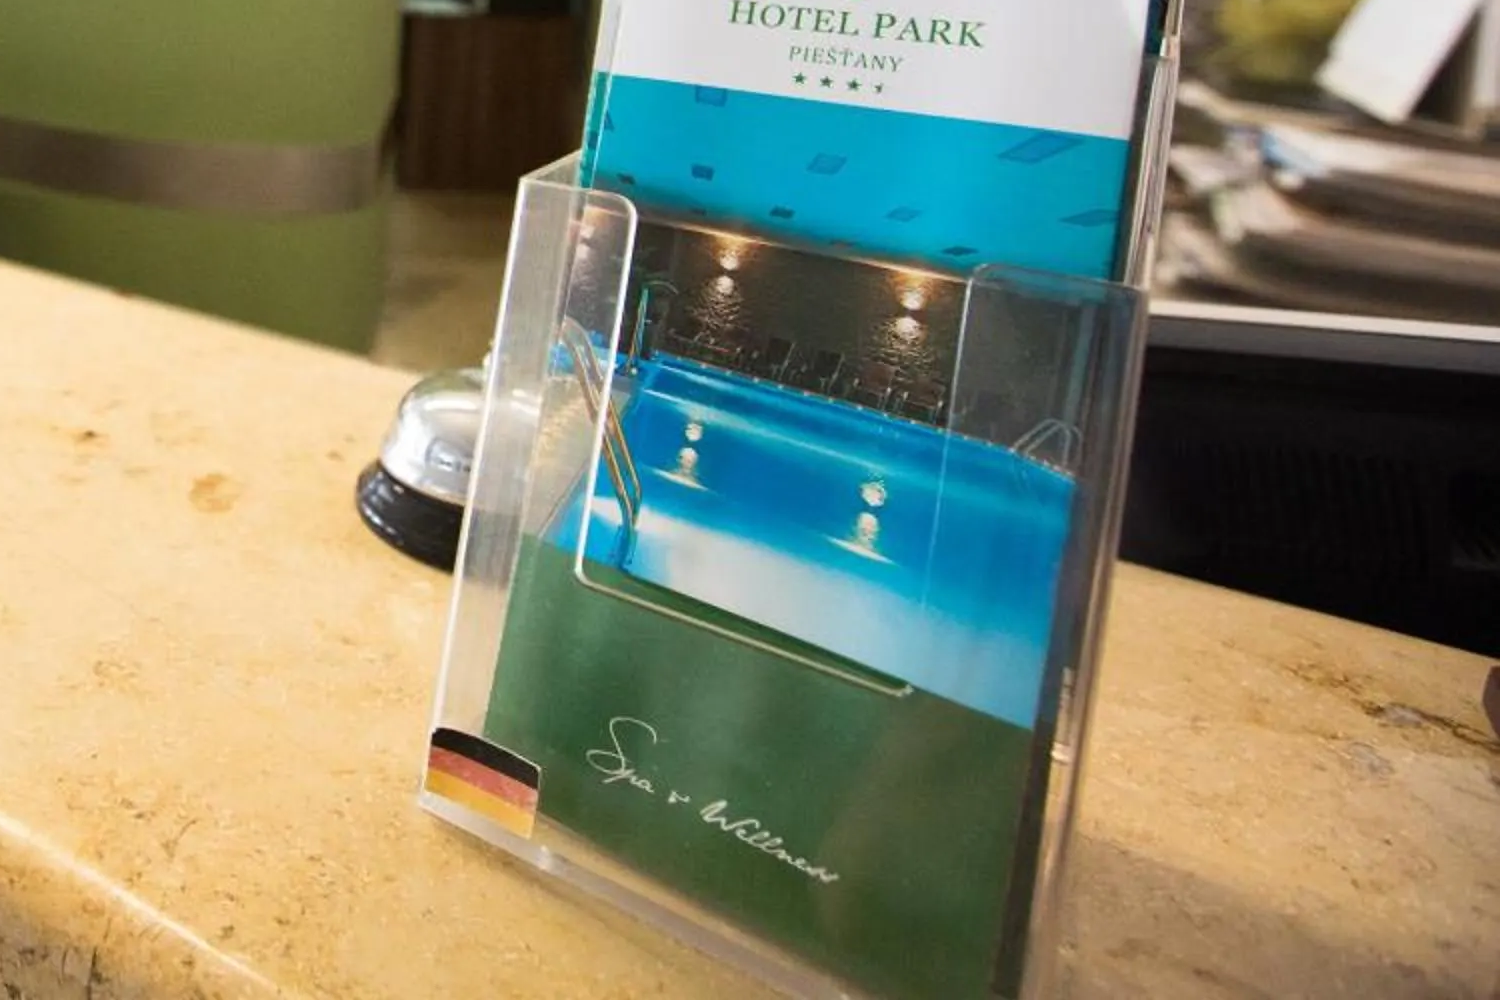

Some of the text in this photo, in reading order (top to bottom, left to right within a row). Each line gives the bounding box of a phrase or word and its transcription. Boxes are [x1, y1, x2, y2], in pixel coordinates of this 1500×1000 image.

[728, 0, 986, 48] HOTEL PARK
[788, 44, 904, 73] PIEŠŤANY
[586, 716, 655, 794] Spa
[699, 799, 840, 883] Wellness
